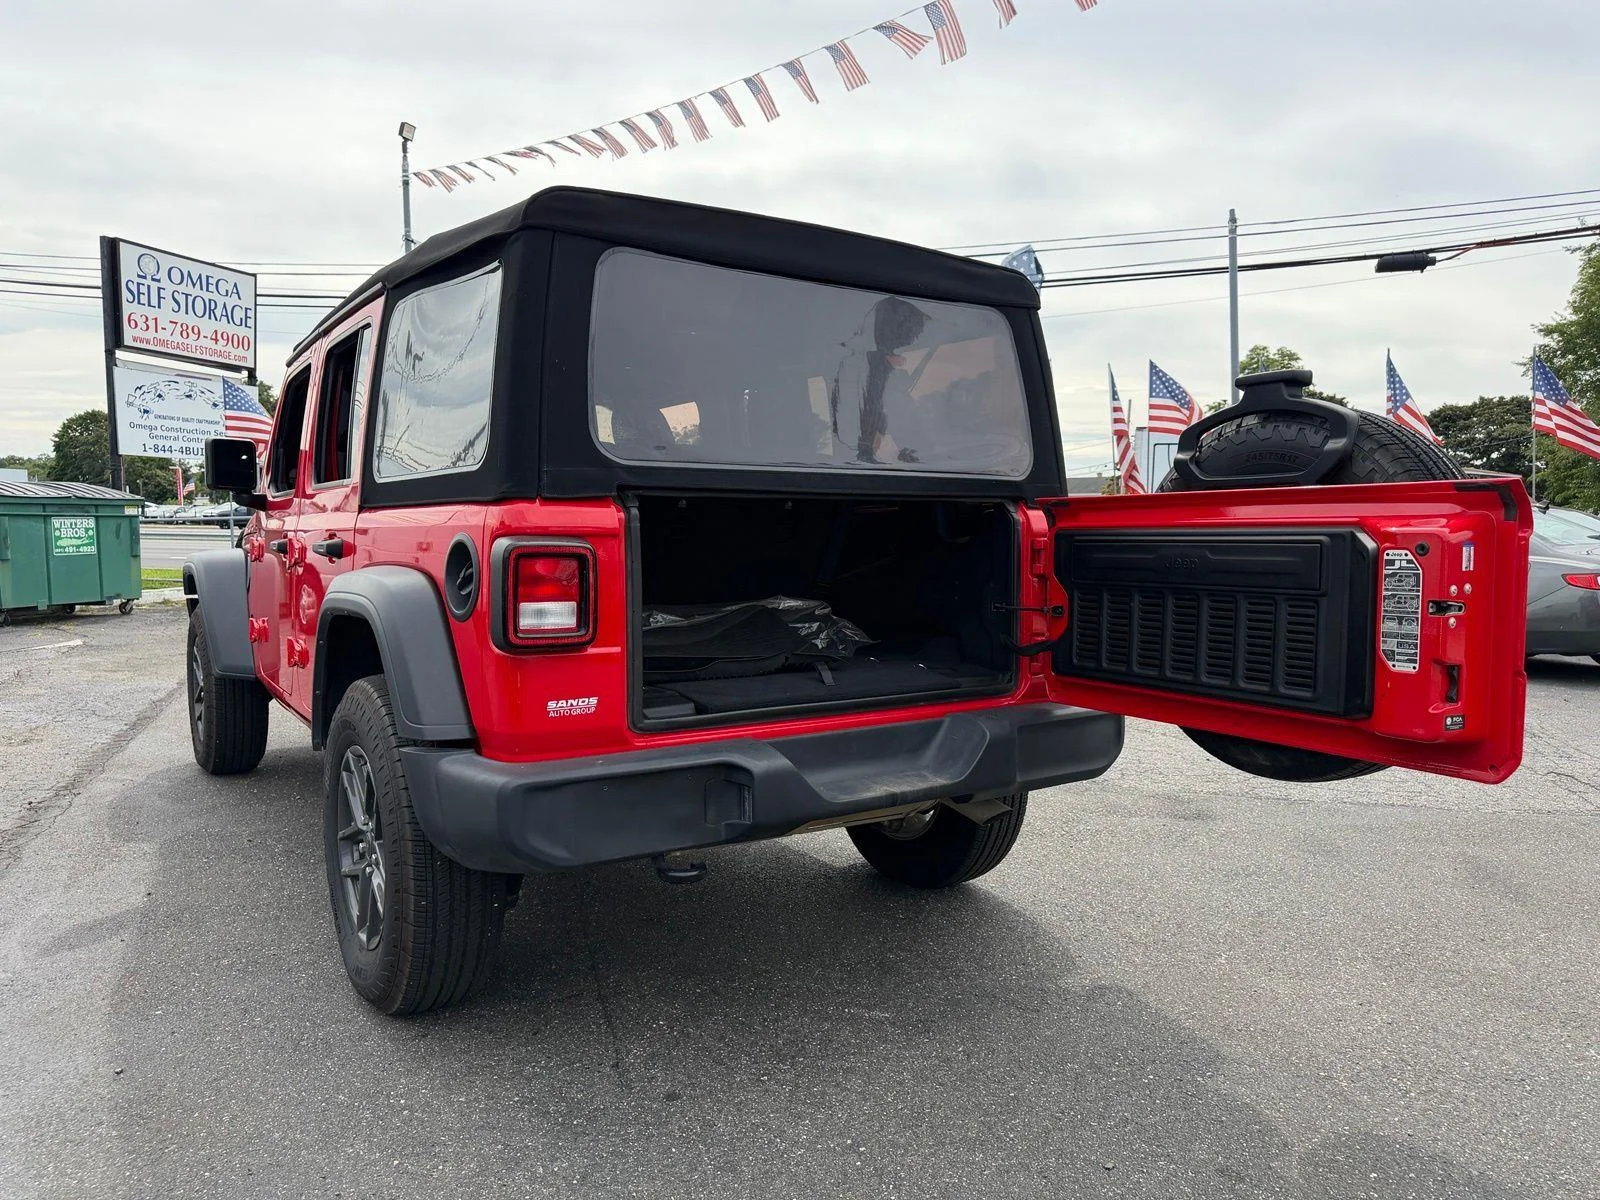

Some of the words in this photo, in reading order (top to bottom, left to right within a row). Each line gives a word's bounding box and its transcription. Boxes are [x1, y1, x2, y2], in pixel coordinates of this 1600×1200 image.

[167, 266, 242, 300] OMEGA
[125, 279, 166, 309] SELF
[171, 289, 252, 329] STORAGE
[127, 311, 251, 352] 631-789-4900
[131, 334, 248, 363] www.OMEGASELFSTORAGE.com
[129, 422, 158, 432] Omega
[160, 424, 211, 436] Construction
[149, 432, 180, 442] General
[53, 518, 94, 529] WINTERS
[547, 697, 599, 708] SANDS
[549, 709, 570, 717] AUTO
[571, 707, 596, 715] GROUP
